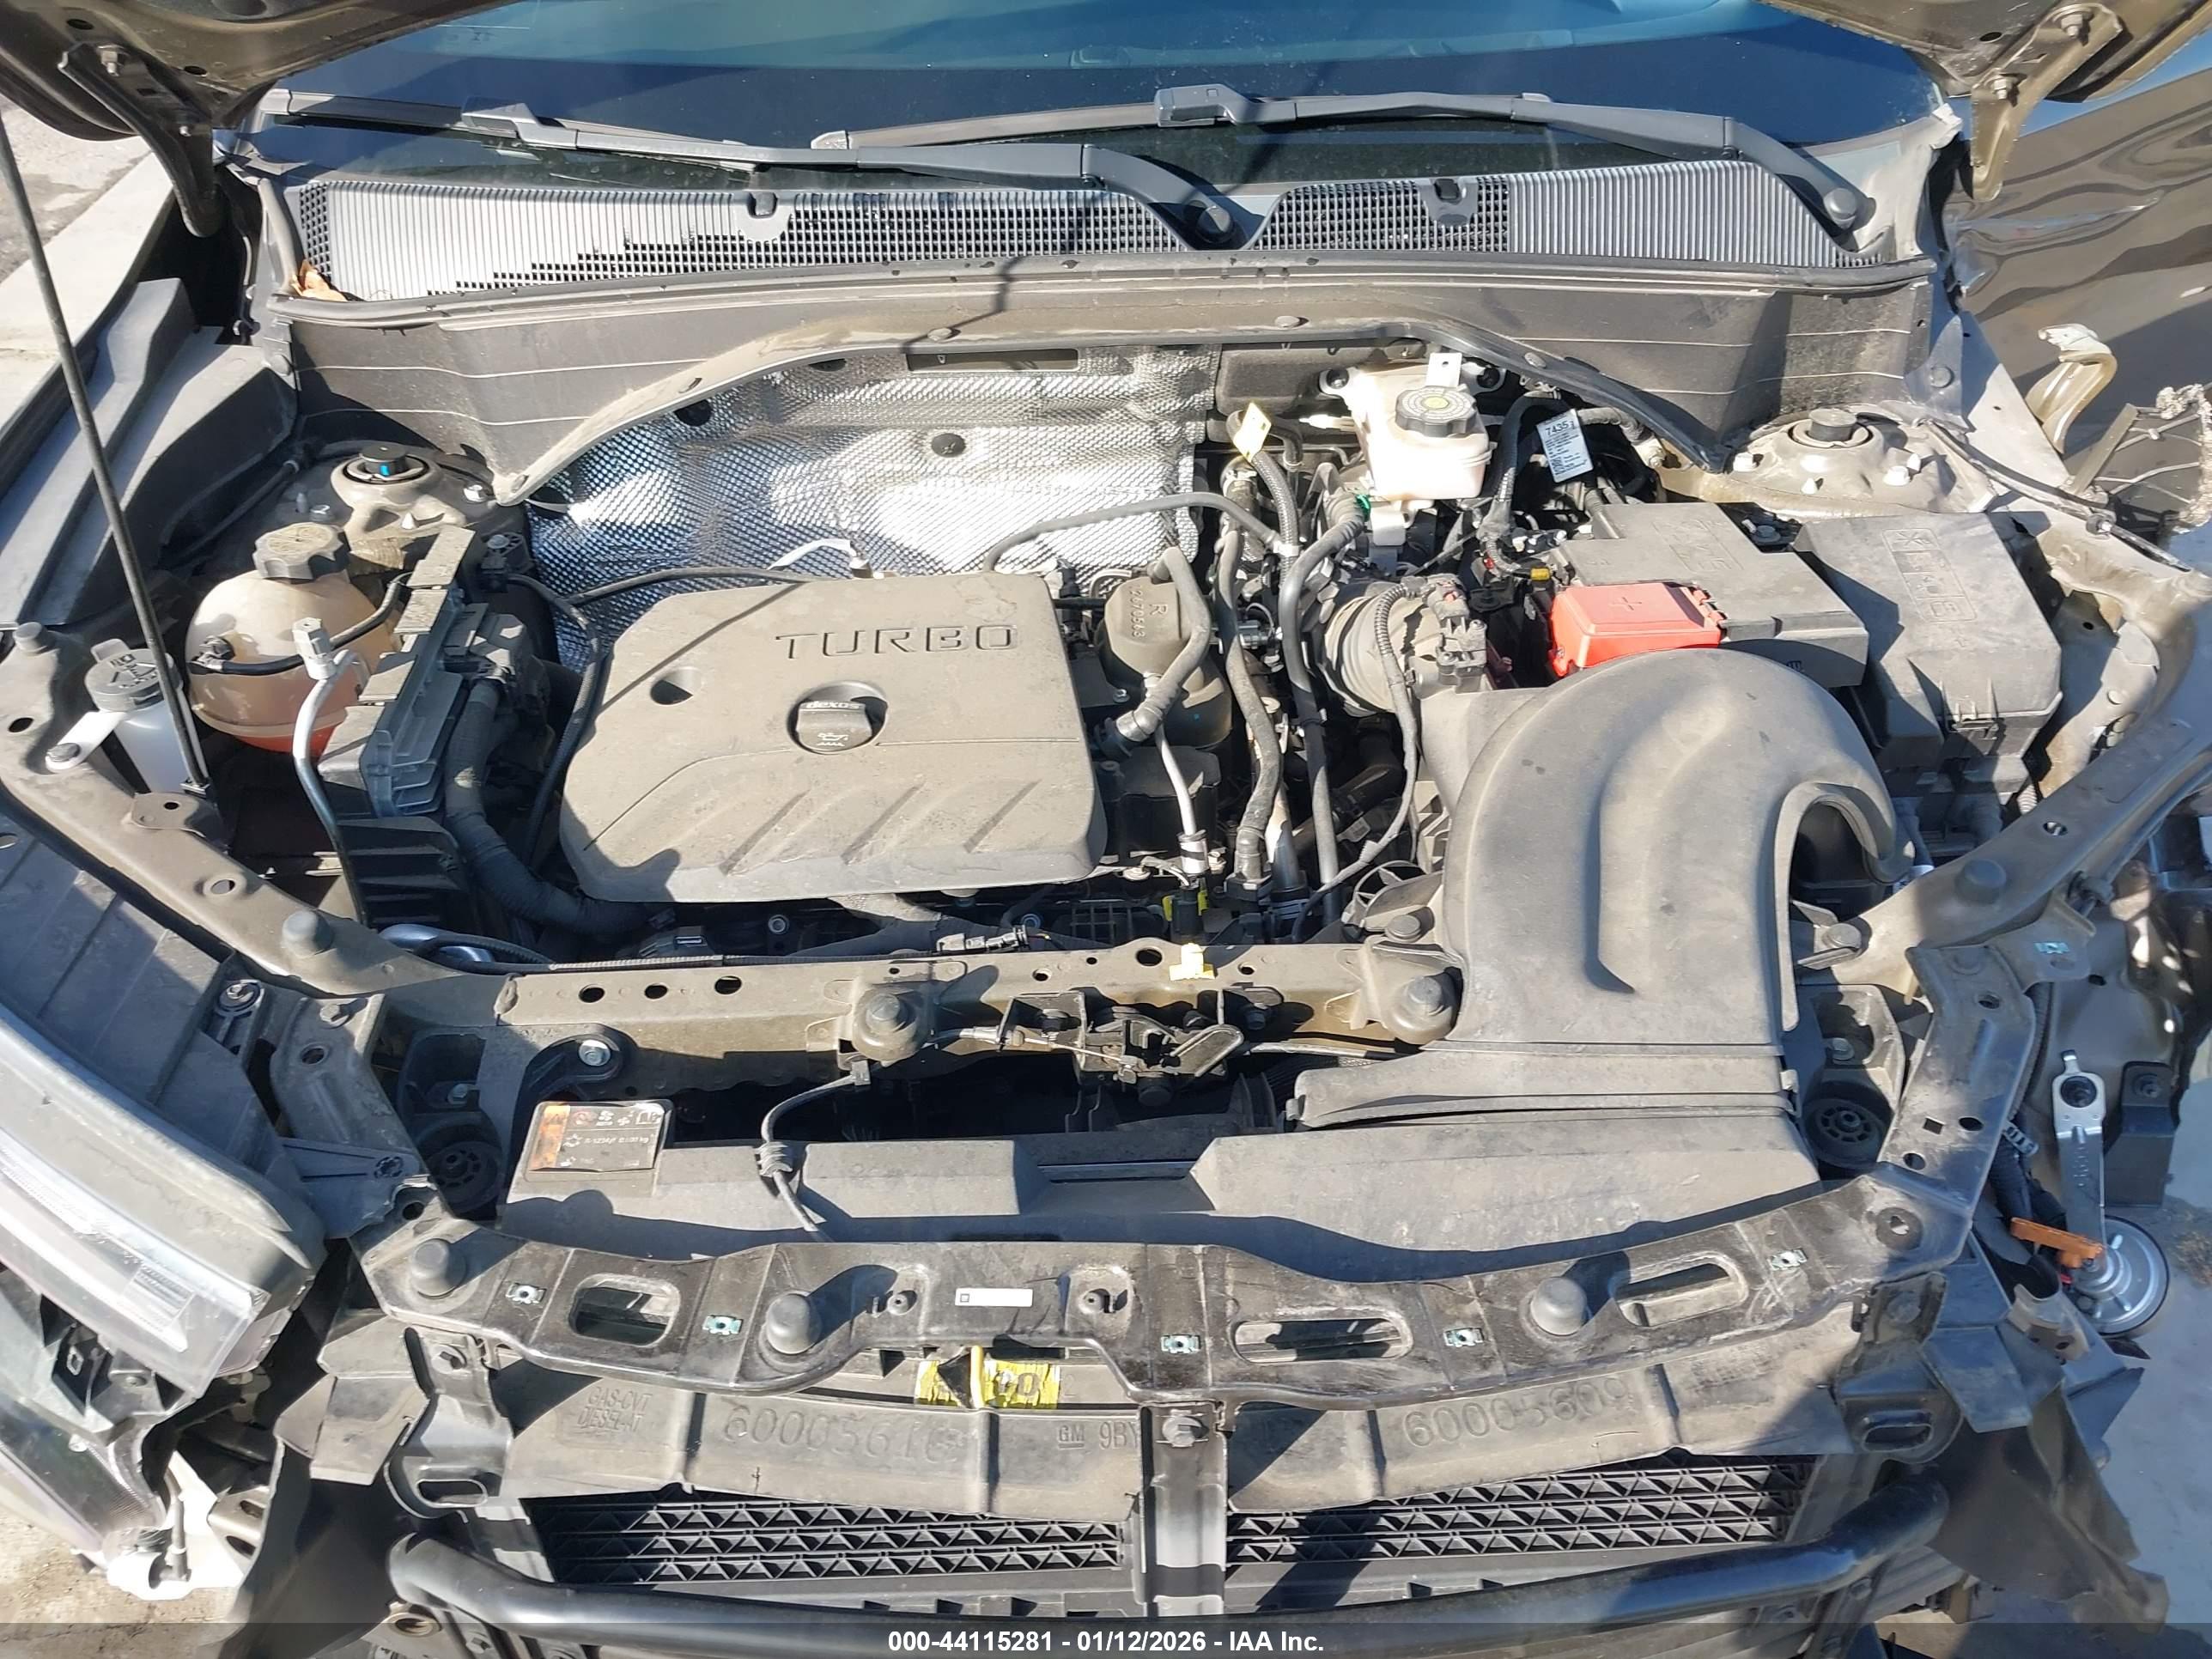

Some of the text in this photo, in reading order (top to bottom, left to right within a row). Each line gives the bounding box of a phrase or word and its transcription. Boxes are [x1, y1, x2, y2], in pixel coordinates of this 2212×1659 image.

[1149, 603, 1170, 617] R
[775, 623, 1020, 660] TURBO
[805, 700, 861, 711] dexos
[1059, 1423, 1085, 1445] GM
